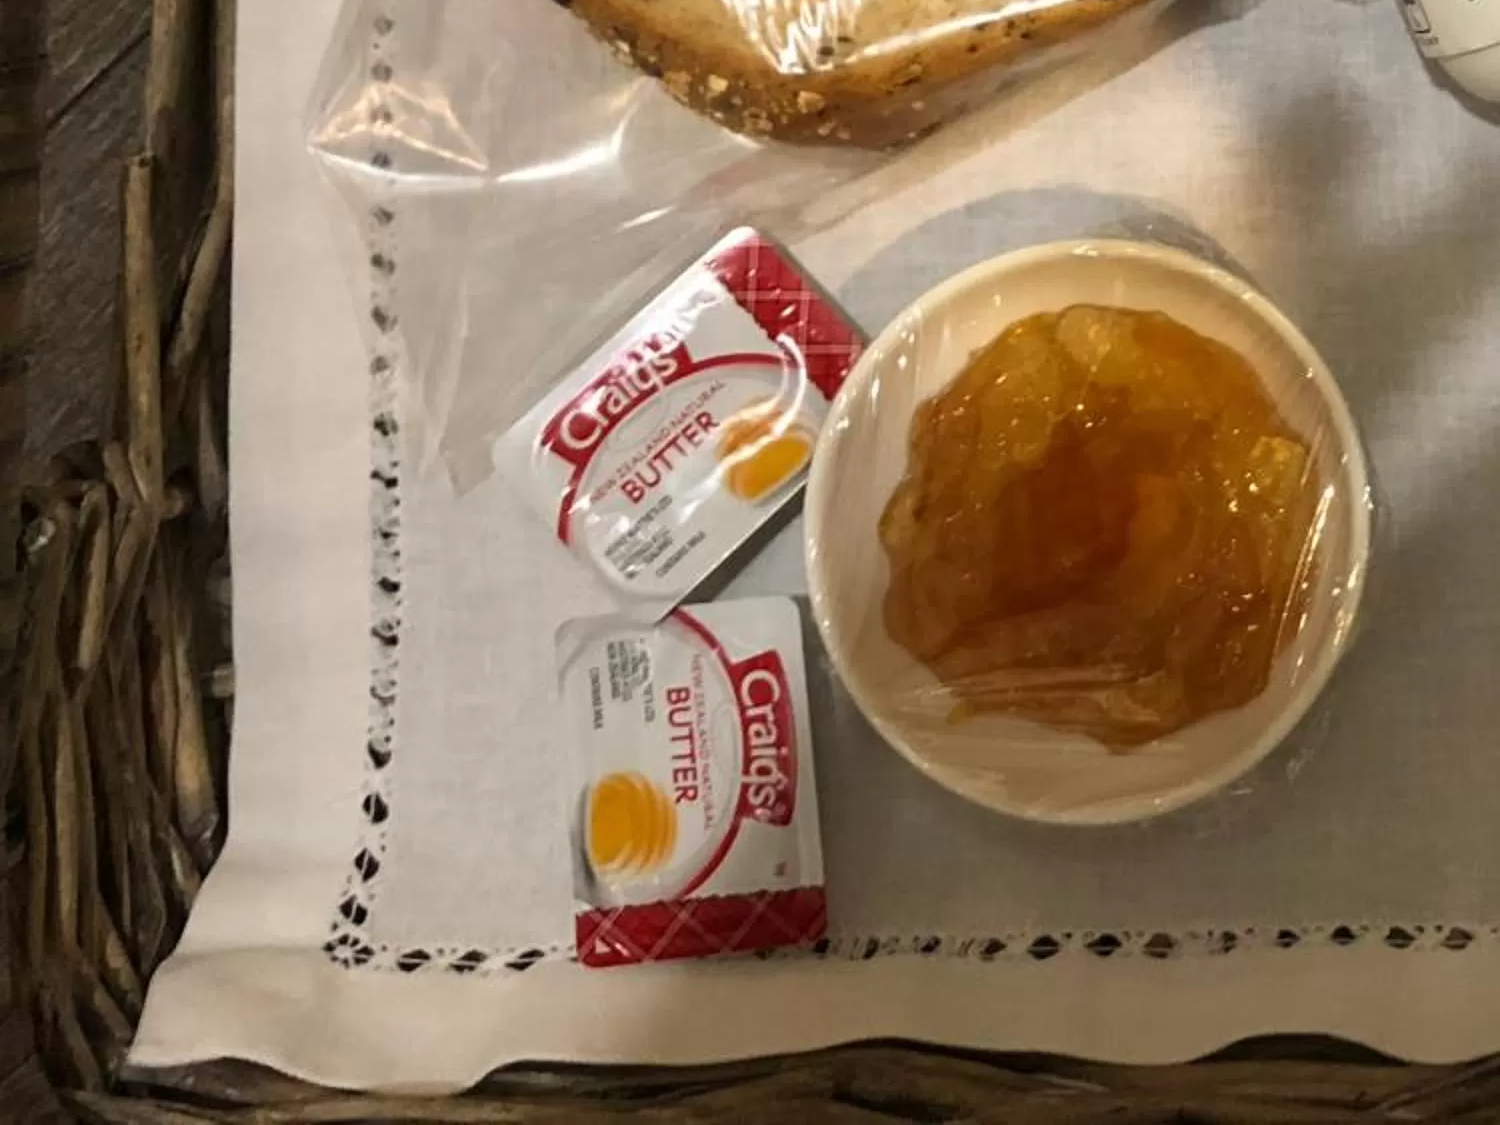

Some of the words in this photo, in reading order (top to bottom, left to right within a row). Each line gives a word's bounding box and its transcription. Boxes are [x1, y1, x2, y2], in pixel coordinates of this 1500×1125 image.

[620, 411, 720, 505] BUTTER
[666, 686, 699, 805] BUTTER
[740, 668, 788, 807] Craig's
